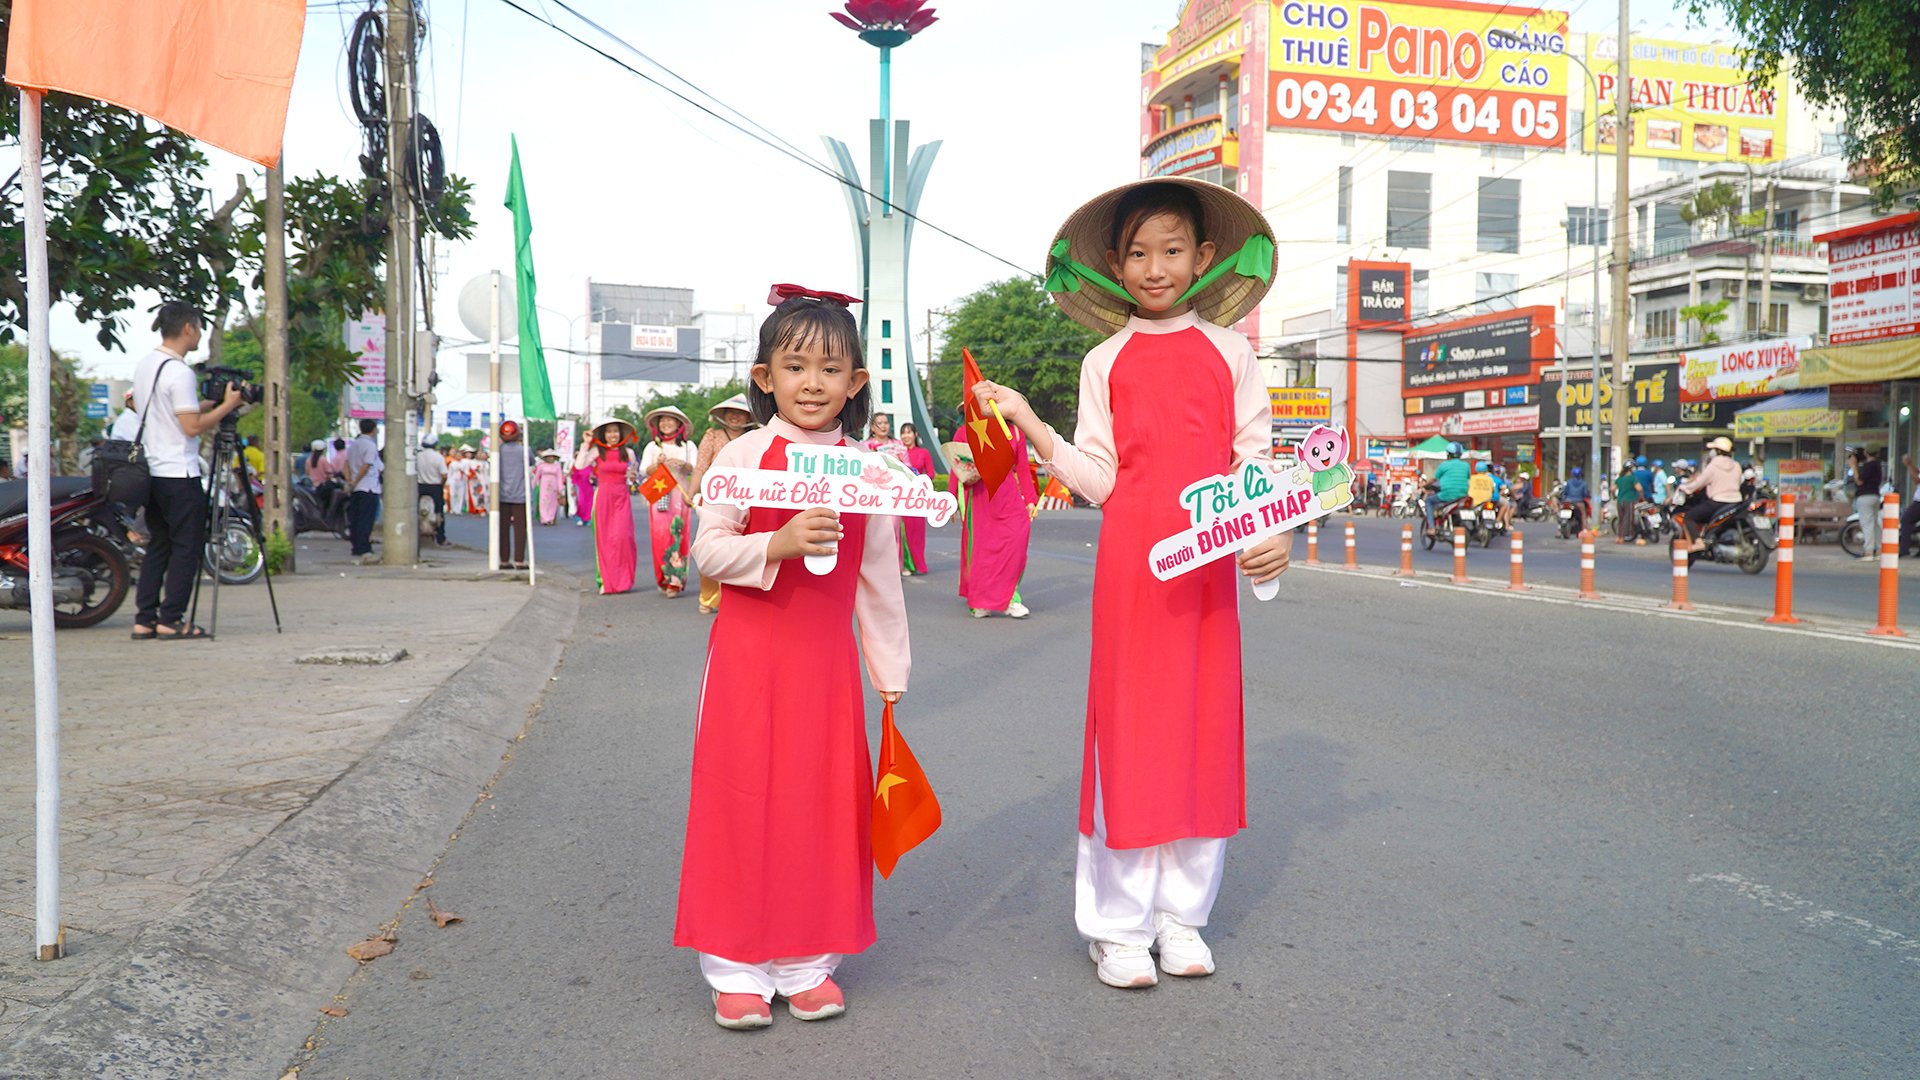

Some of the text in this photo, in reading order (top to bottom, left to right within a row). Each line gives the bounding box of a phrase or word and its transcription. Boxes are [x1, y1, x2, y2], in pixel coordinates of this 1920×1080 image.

[1283, 2, 1349, 30] CHO
[1282, 37, 1349, 67] THUÊ
[1357, 5, 1485, 82] Pano
[1486, 24, 1565, 54] QUẢNG
[1501, 60, 1549, 87] CÁO
[1276, 77, 1560, 140] 0934 03 04 05
[1361, 293, 1382, 308] TRẢ
[1372, 278, 1394, 293] BÁN
[1450, 346, 1506, 361] Shop.com.vn
[1722, 352, 1754, 374] LONG
[1556, 370, 1668, 407] QUỐ TẾ
[791, 451, 862, 479] Tự hào
[706, 474, 953, 522] Phụ nữ Đất Sen Hồng
[1185, 463, 1274, 524] Tôi là
[1156, 489, 1312, 574] NGƯỜI ĐỒNG THÁP
